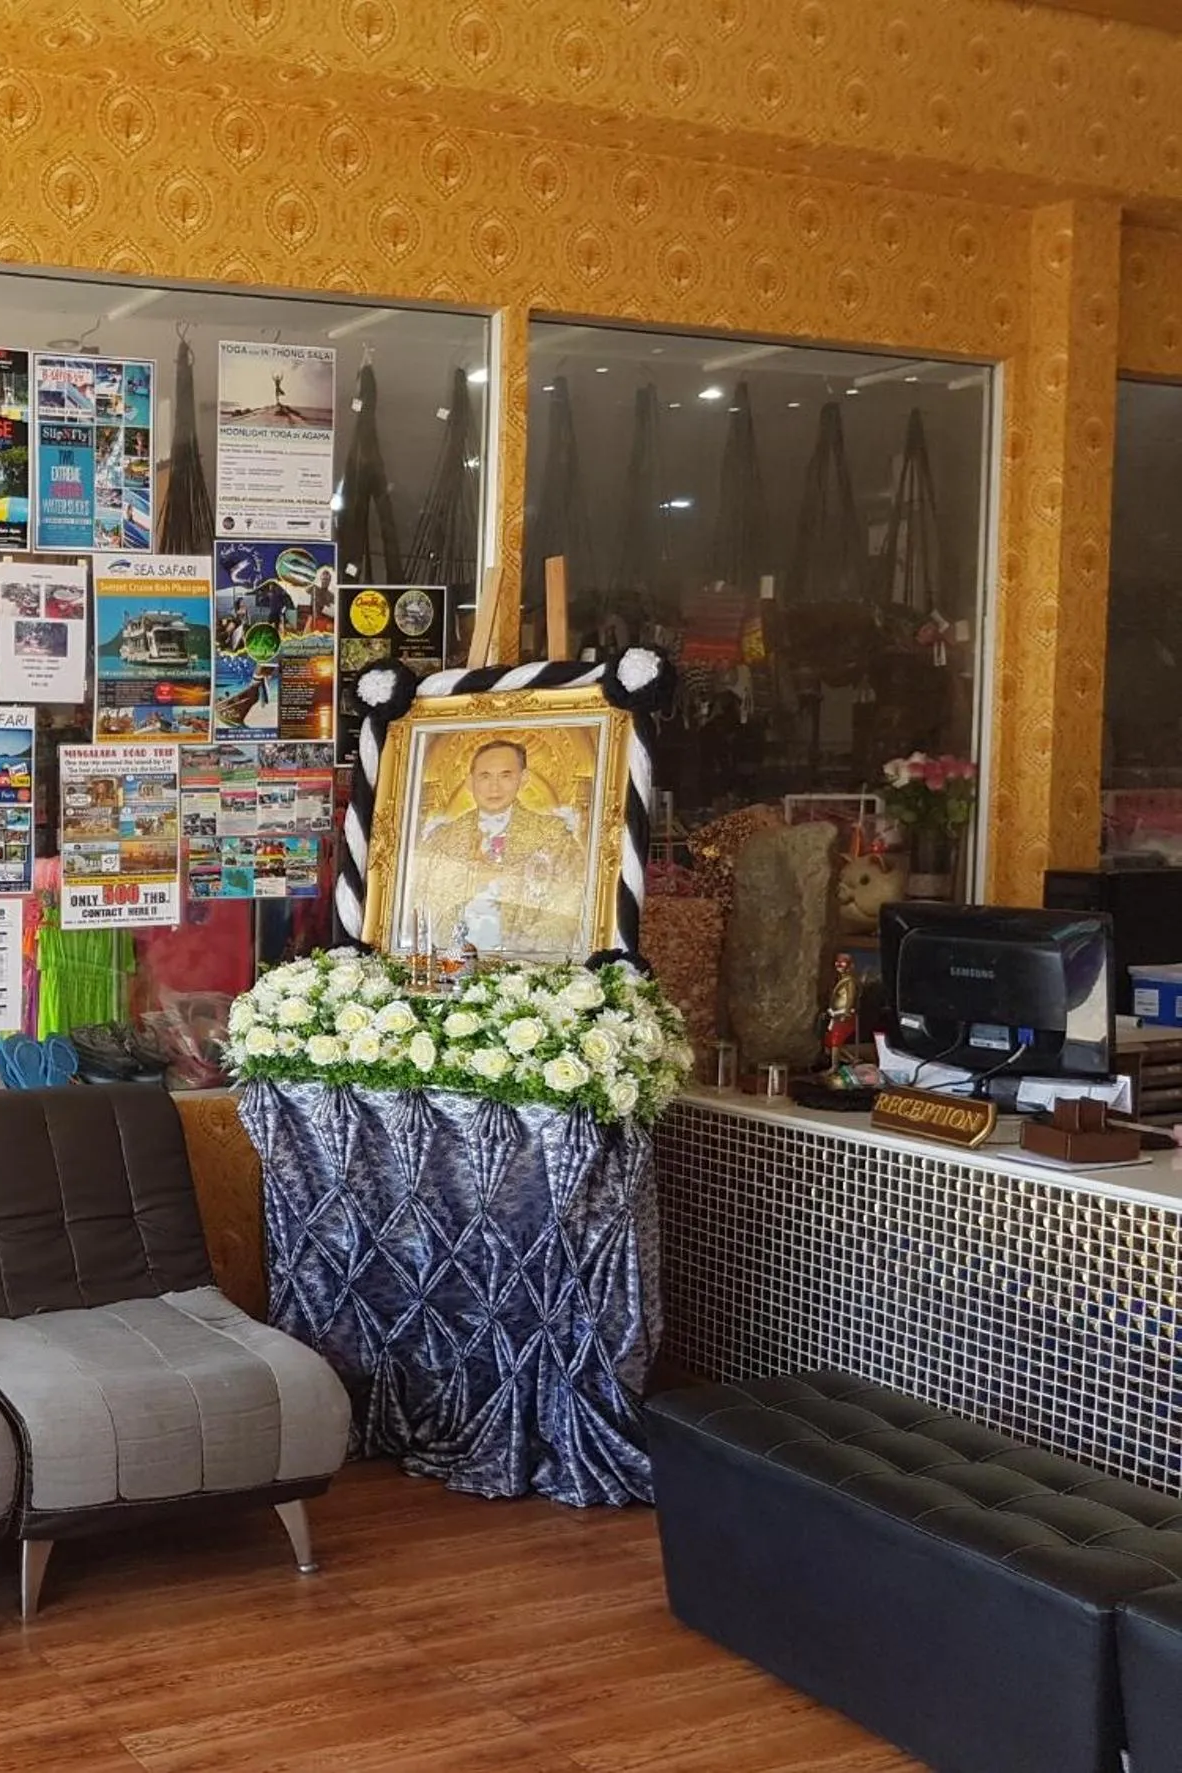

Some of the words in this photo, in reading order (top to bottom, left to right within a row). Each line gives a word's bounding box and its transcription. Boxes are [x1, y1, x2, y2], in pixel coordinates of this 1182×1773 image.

[221, 344, 248, 355] YOGA
[272, 347, 305, 359] THONG
[219, 428, 268, 438] MOONLIGHT
[270, 430, 292, 439] YOGA
[302, 432, 330, 441] AGAMA
[133, 563, 157, 577] SEA
[158, 564, 197, 577] SAFARI
[100, 582, 127, 593] Sunset
[70, 895, 98, 907] ONLY
[82, 908, 123, 918] CONTACT
[128, 907, 149, 916] HERE
[950, 966, 996, 979] SAMSUNG
[874, 1092, 983, 1134] RECEPTION
